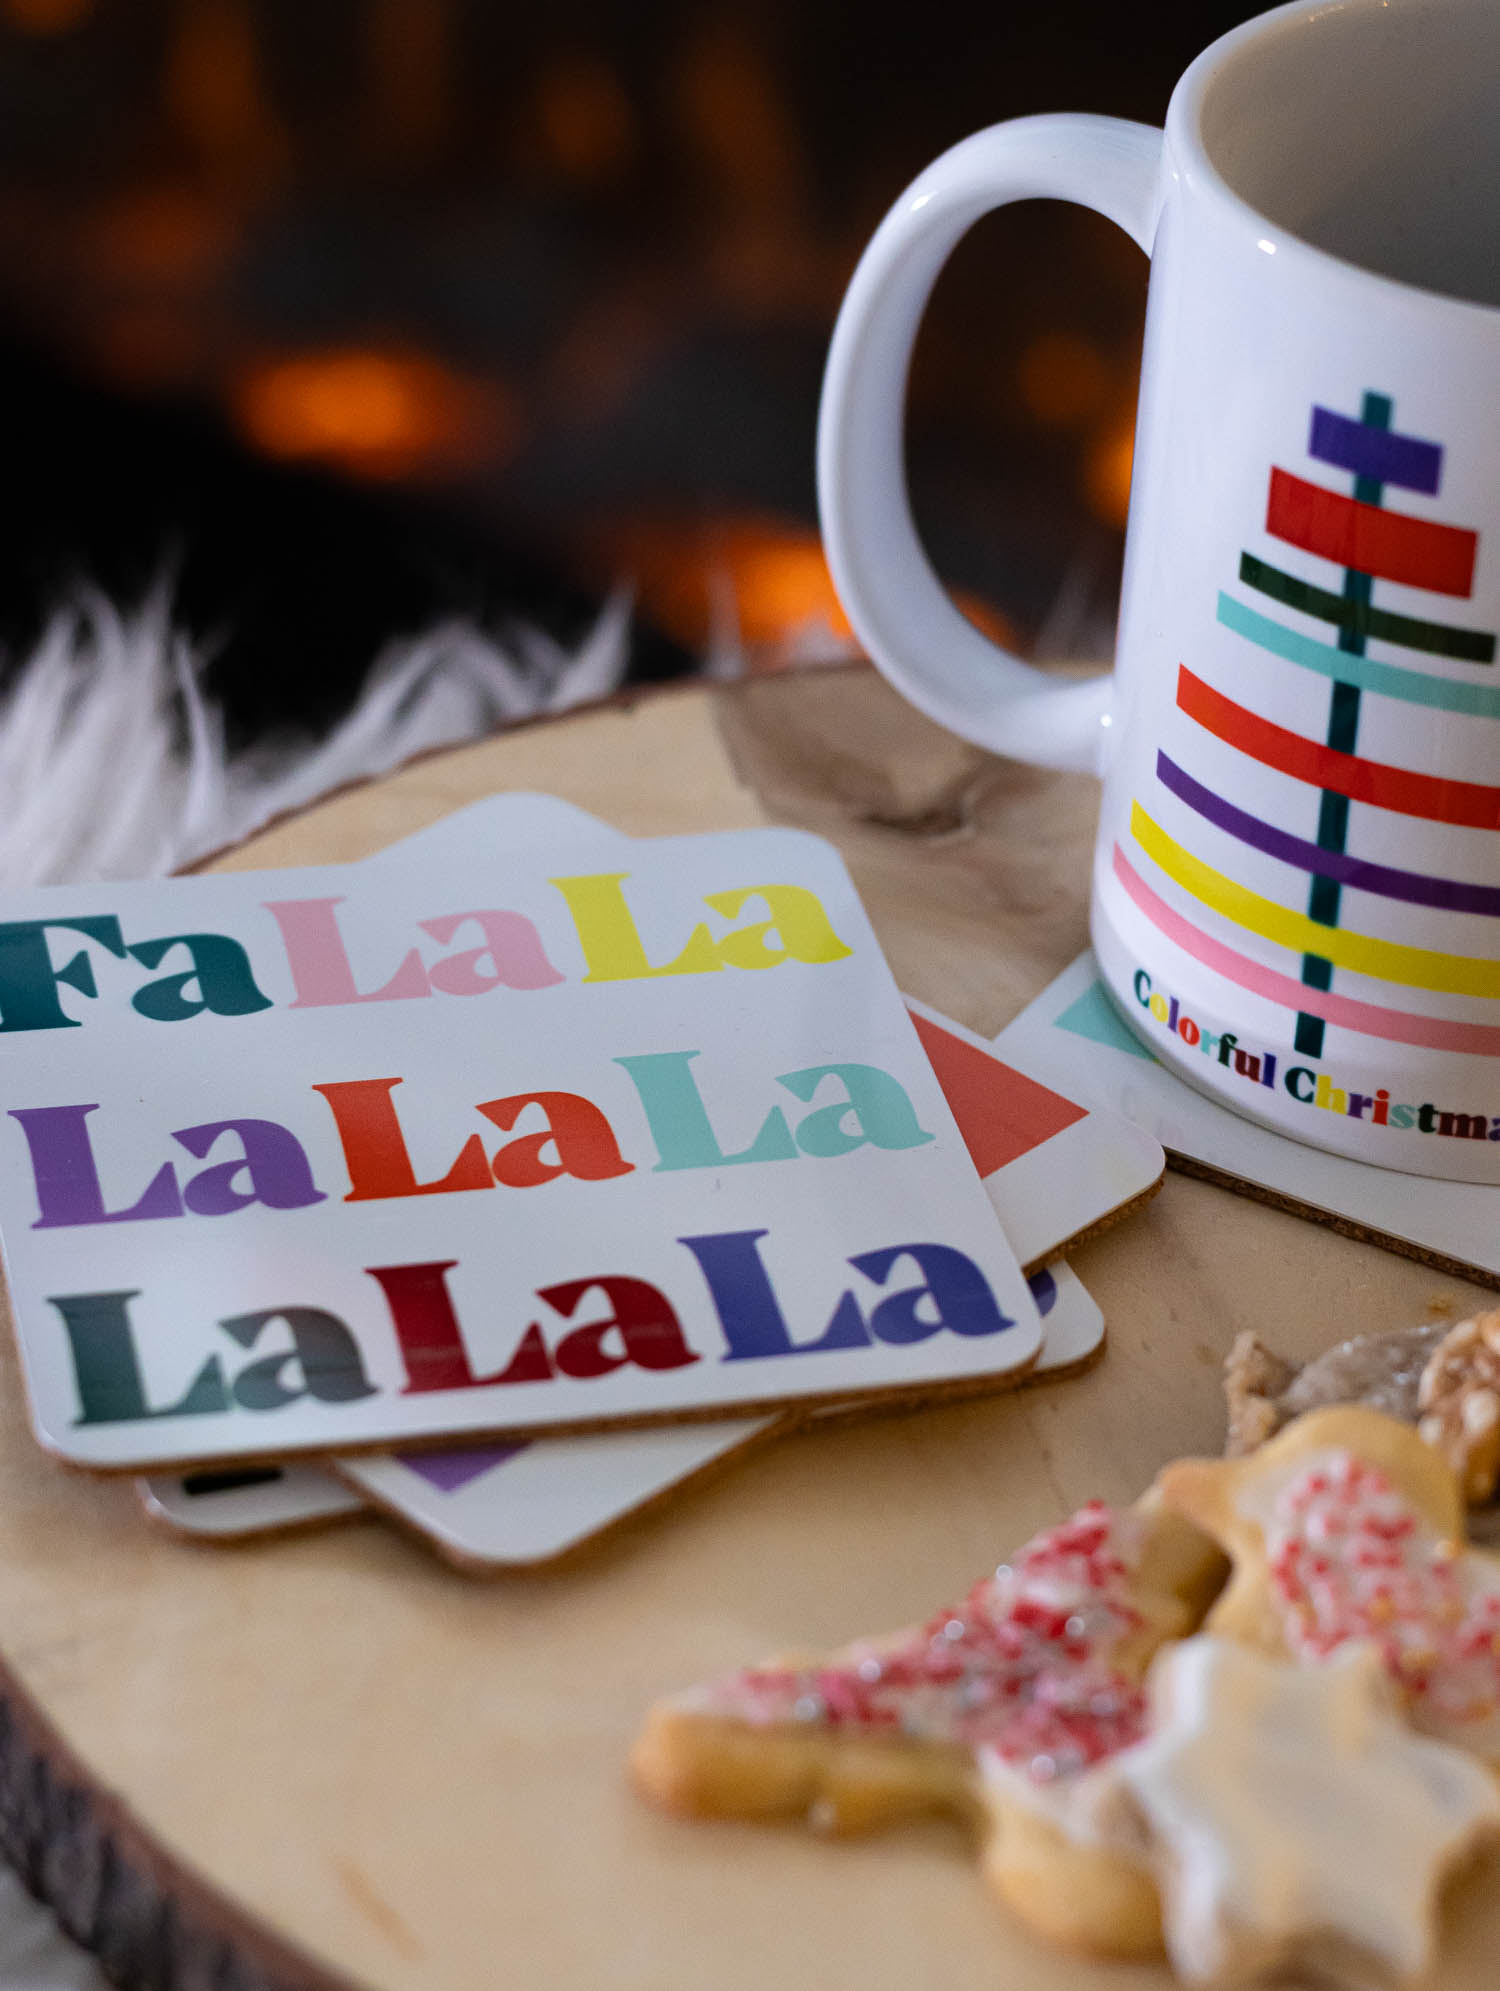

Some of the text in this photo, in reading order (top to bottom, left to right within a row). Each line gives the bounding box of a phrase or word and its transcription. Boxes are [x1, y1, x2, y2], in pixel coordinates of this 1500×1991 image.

[0, 874, 853, 1032] Fa La La
[1134, 970, 1276, 1088] Colorful
[8, 1051, 935, 1229] La La La
[48, 1230, 1014, 1425] La La La
